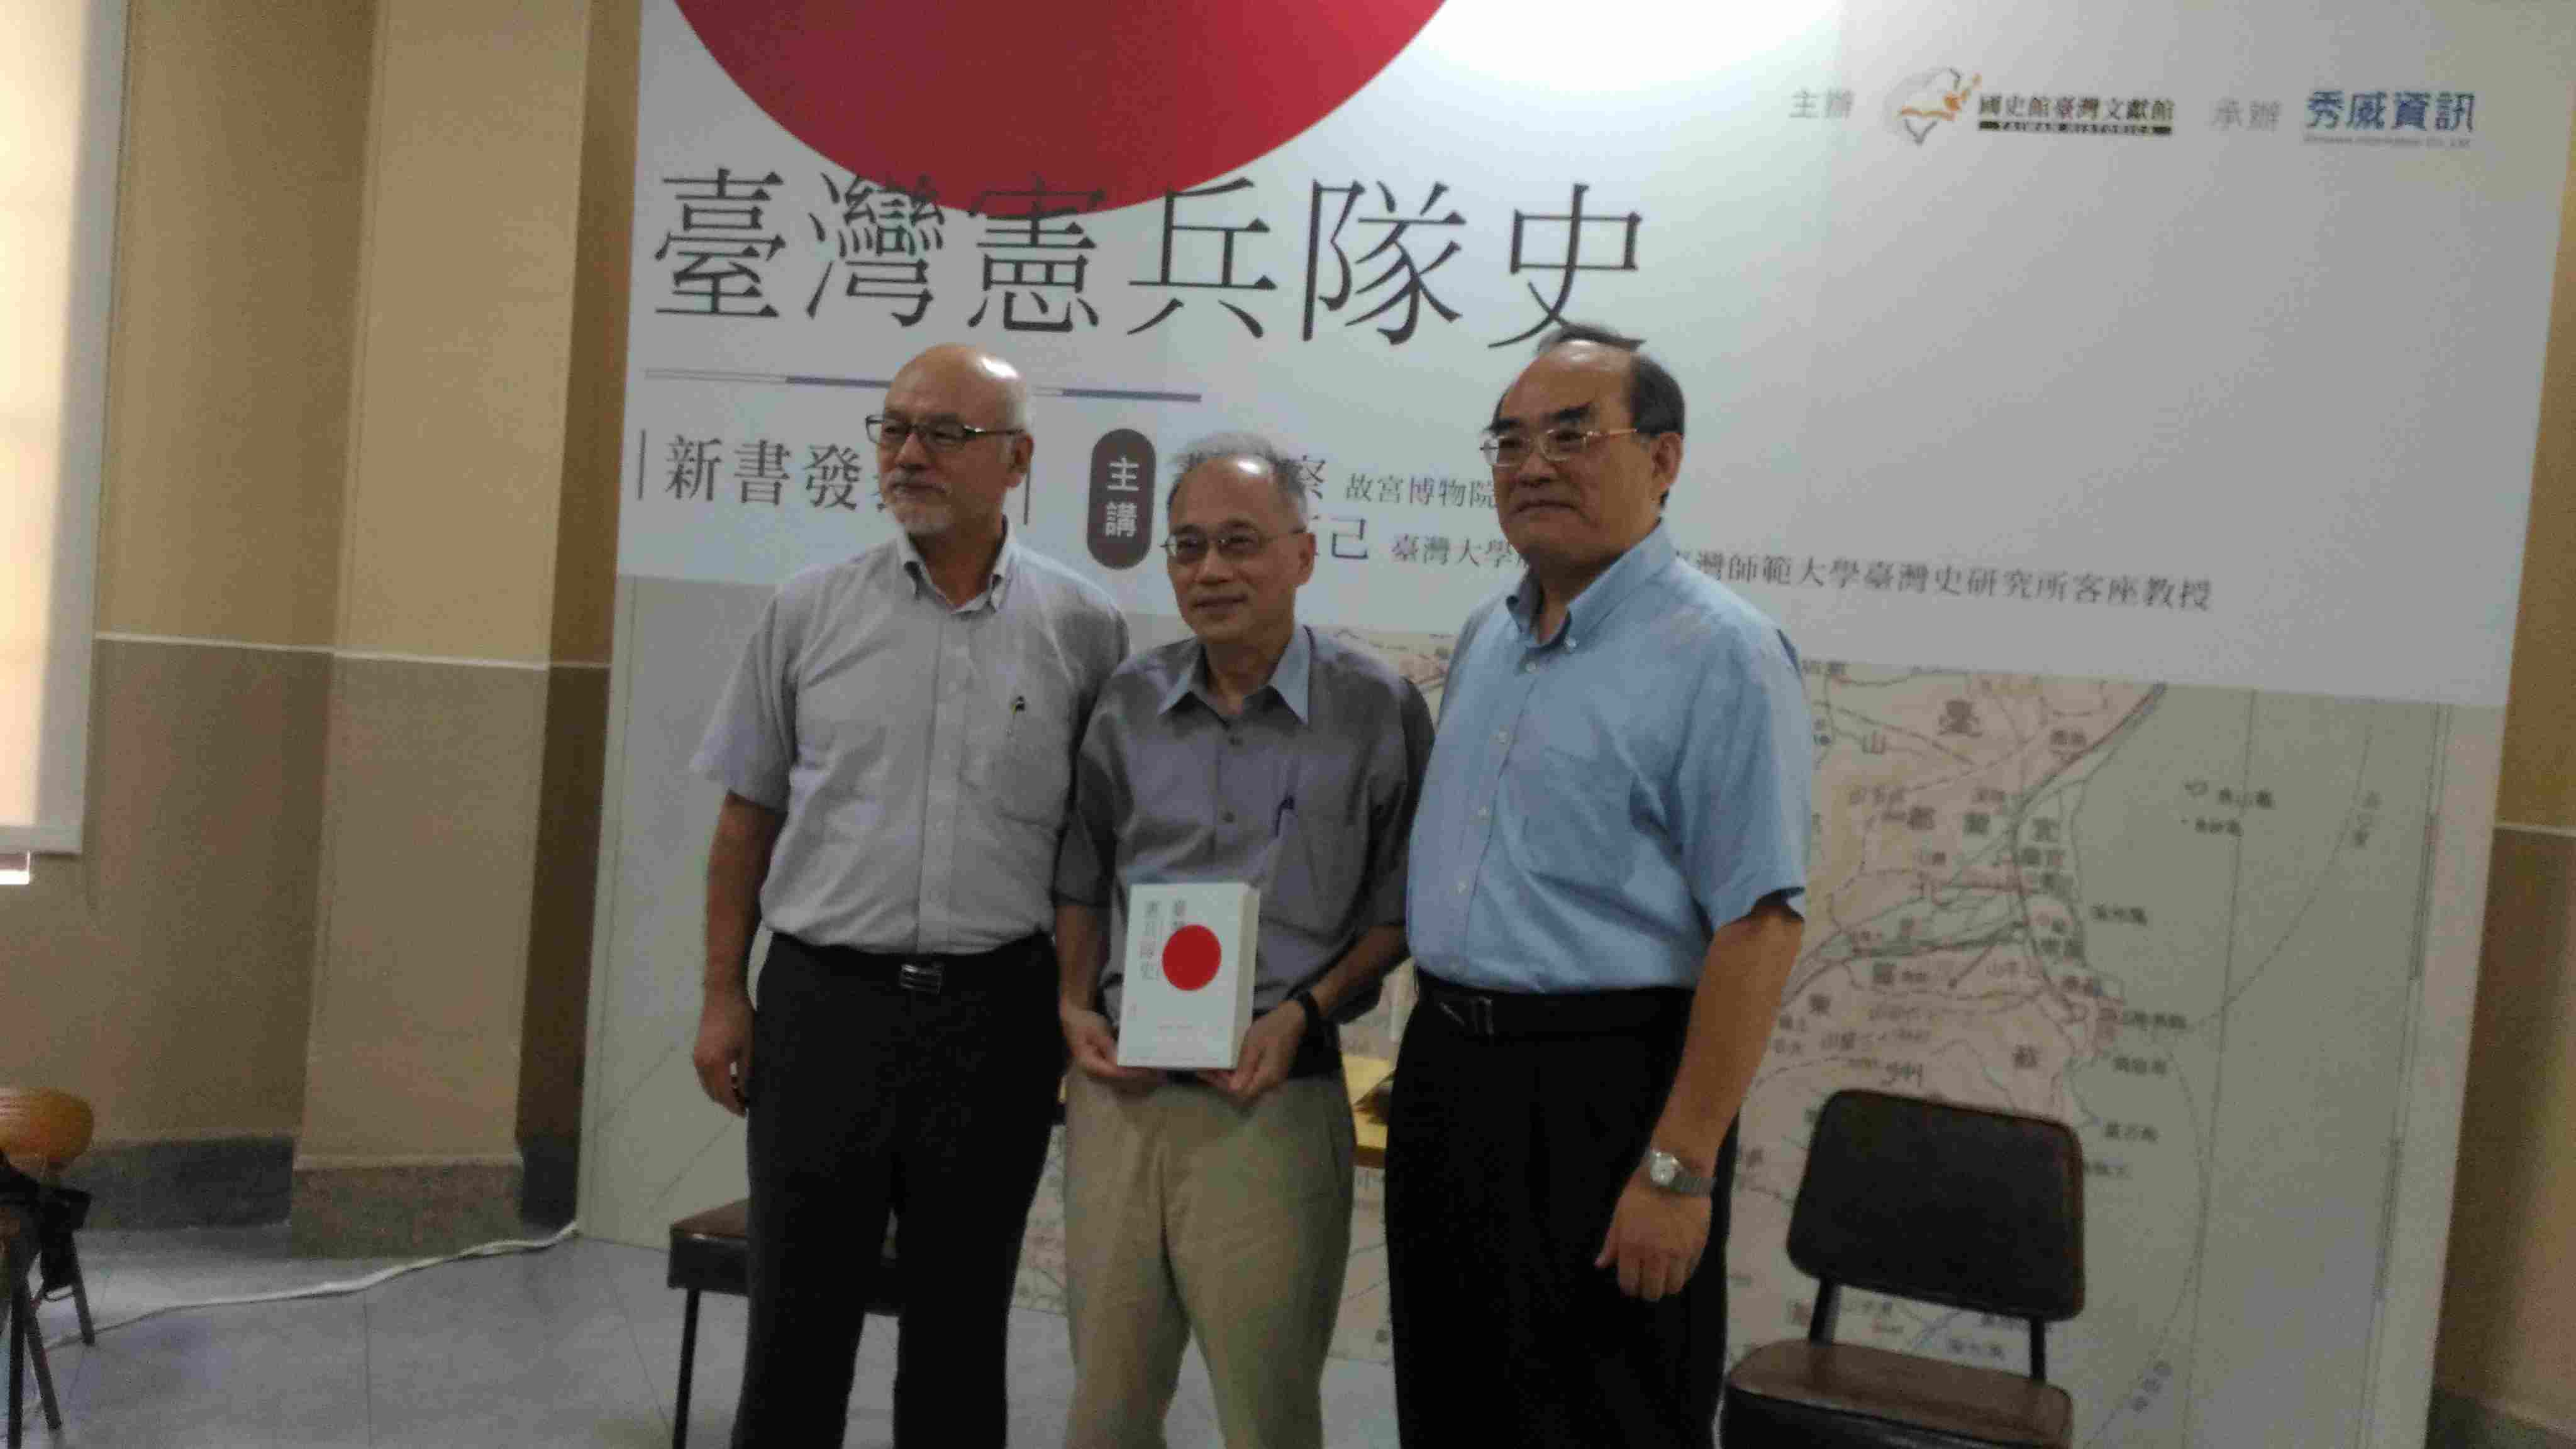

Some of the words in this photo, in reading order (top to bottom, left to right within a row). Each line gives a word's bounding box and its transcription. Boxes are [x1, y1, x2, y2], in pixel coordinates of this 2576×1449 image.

[2304, 89, 2476, 132] 秀威資訊
[654, 167, 1648, 350] 臺灣憲兵隊史
[665, 433, 887, 513] 新書發
[1104, 455, 1140, 538] 主講
[1345, 472, 1496, 508] 故宮博物院
[1391, 535, 1521, 569] 臺灣大學
[1674, 548, 2212, 613] 灣師範大學臺灣史研究所客座教授
